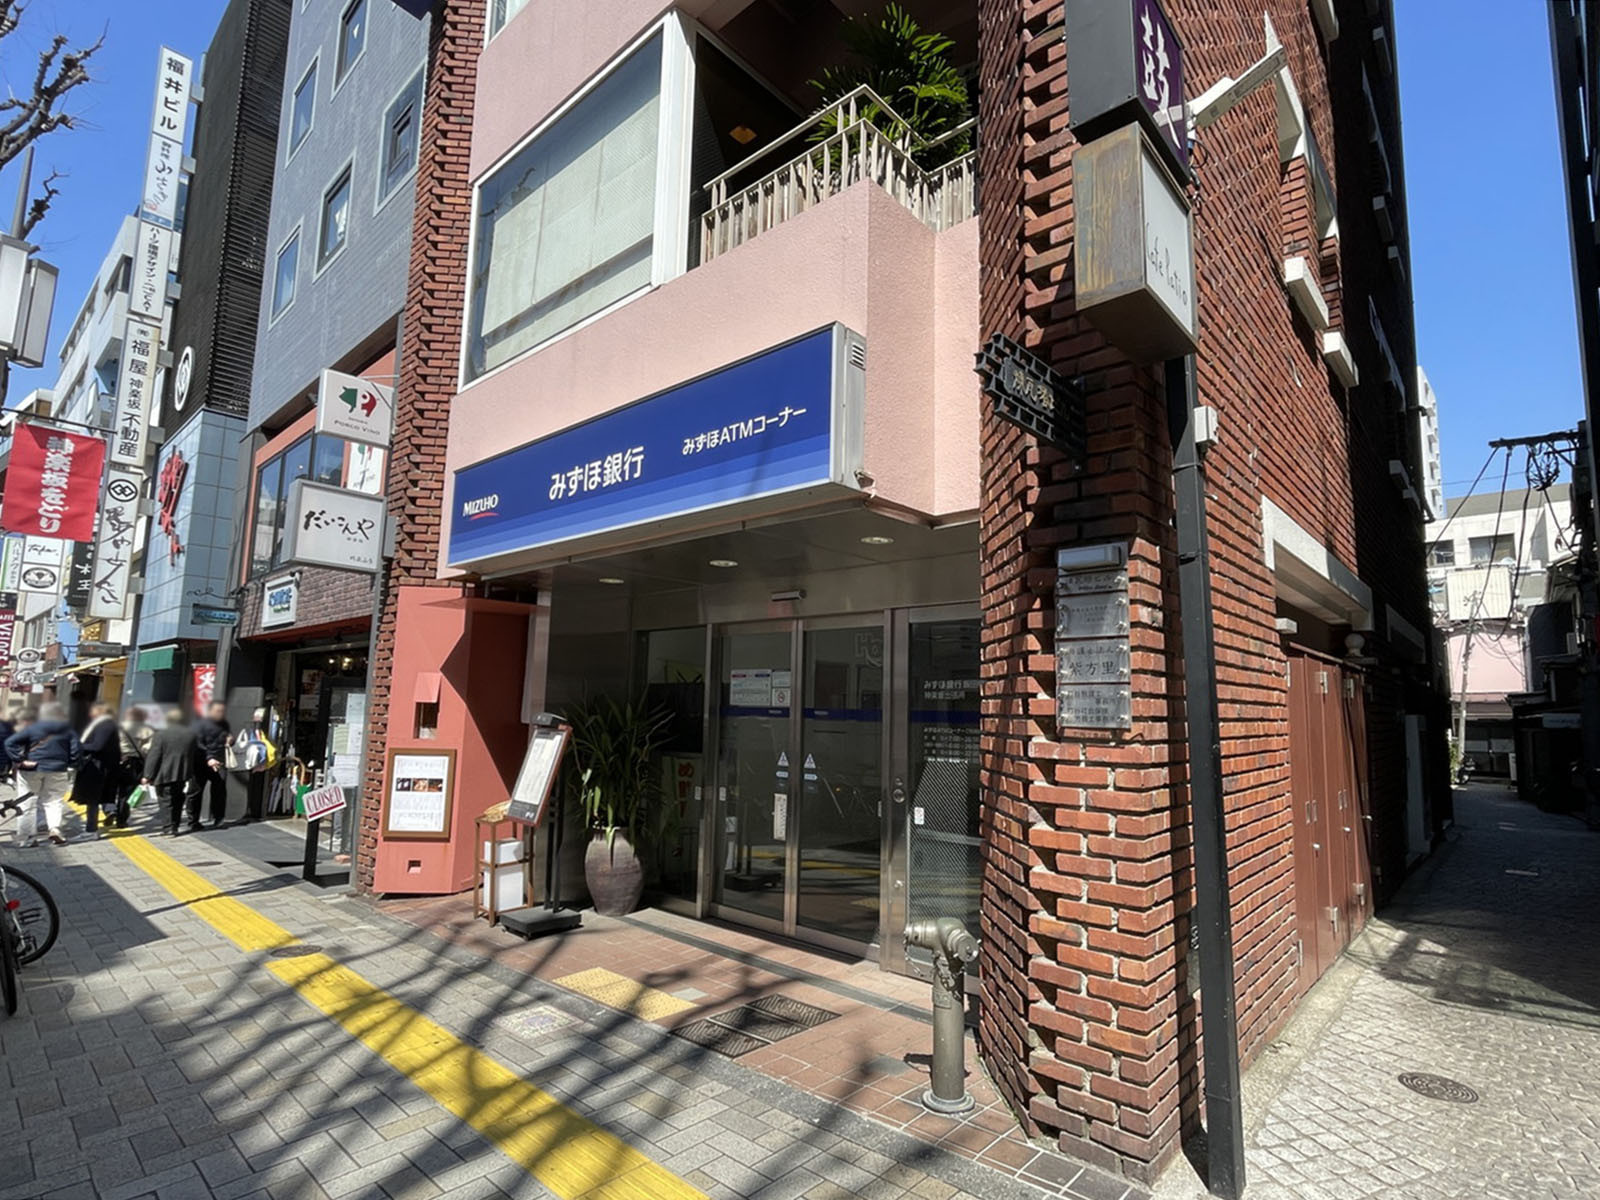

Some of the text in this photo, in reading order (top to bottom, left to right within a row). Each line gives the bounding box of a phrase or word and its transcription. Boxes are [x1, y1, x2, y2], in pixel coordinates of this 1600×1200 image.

[682, 406, 807, 455] みずほATMコーナー
[38, 436, 75, 533] 神楽坂をどり
[548, 445, 645, 501] みずほ銀行
[462, 493, 499, 517] MIZUHO
[303, 510, 375, 540] だいこんや
[306, 785, 343, 813] CLOSED
